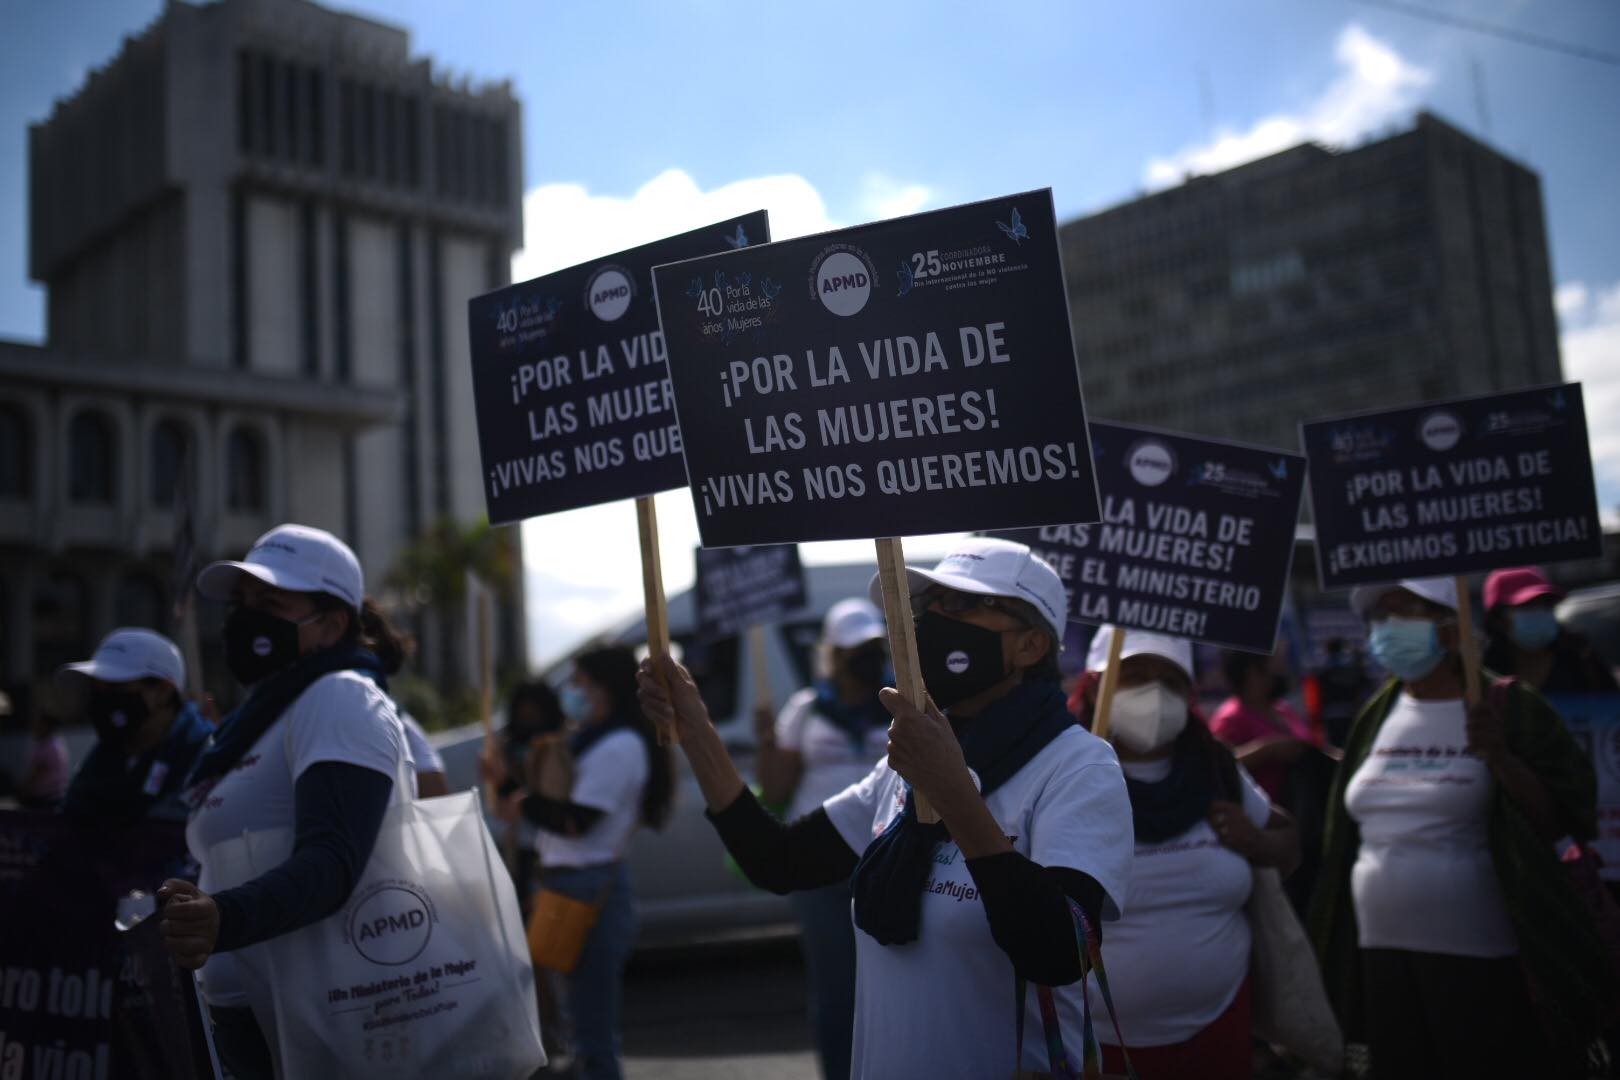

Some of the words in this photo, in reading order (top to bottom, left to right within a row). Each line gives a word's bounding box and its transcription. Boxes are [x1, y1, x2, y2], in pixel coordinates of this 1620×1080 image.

[912, 250, 942, 279] 25
[942, 253, 1006, 272] NOVIEMBRE
[593, 285, 629, 306] APMD
[697, 287, 723, 317] 40
[726, 286, 741, 299] Por
[741, 284, 750, 296] la
[823, 273, 867, 294] APMD
[496, 309, 518, 334] 40
[726, 300, 745, 313] vida
[746, 297, 758, 310] de
[758, 296, 771, 308] las
[727, 316, 762, 332] Mujeres
[703, 320, 723, 335] años
[510, 355, 572, 405] ¡POR
[579, 345, 615, 382] LA
[720, 354, 797, 407] ¡POR
[807, 346, 850, 388] LA
[858, 330, 948, 377] VIDA
[960, 322, 1011, 367] DE
[528, 403, 577, 441] LAS
[744, 412, 806, 454] LAS
[818, 389, 999, 447] MUJERES!
[490, 451, 567, 498] ¡VIVAS
[574, 438, 625, 474] NOS
[701, 470, 794, 516] ¡VIVAS
[802, 463, 866, 500] NOS
[877, 442, 1080, 496] QUEREMOS!
[1346, 472, 1404, 506] ¡POR
[1411, 466, 1443, 492] LA
[1449, 457, 1510, 486] VIDA
[1518, 450, 1551, 477] DE
[1104, 495, 1136, 527] LA
[1147, 501, 1208, 538] VIDA
[1218, 514, 1254, 546] DE
[1361, 506, 1410, 533] LAS
[1418, 487, 1543, 525] MUJERES!
[1039, 524, 1090, 549] LAS
[1099, 526, 1235, 573] MUJERES!
[1329, 534, 1458, 576] ¡EXIGIMOS
[1466, 517, 1589, 555] JUSTICIA!
[1081, 558, 1108, 586] EL
[1116, 565, 1261, 612] MINISTERIO
[1080, 593, 1110, 620] LA
[1117, 600, 1208, 637] MUJER!
[359, 909, 425, 942] APMD
